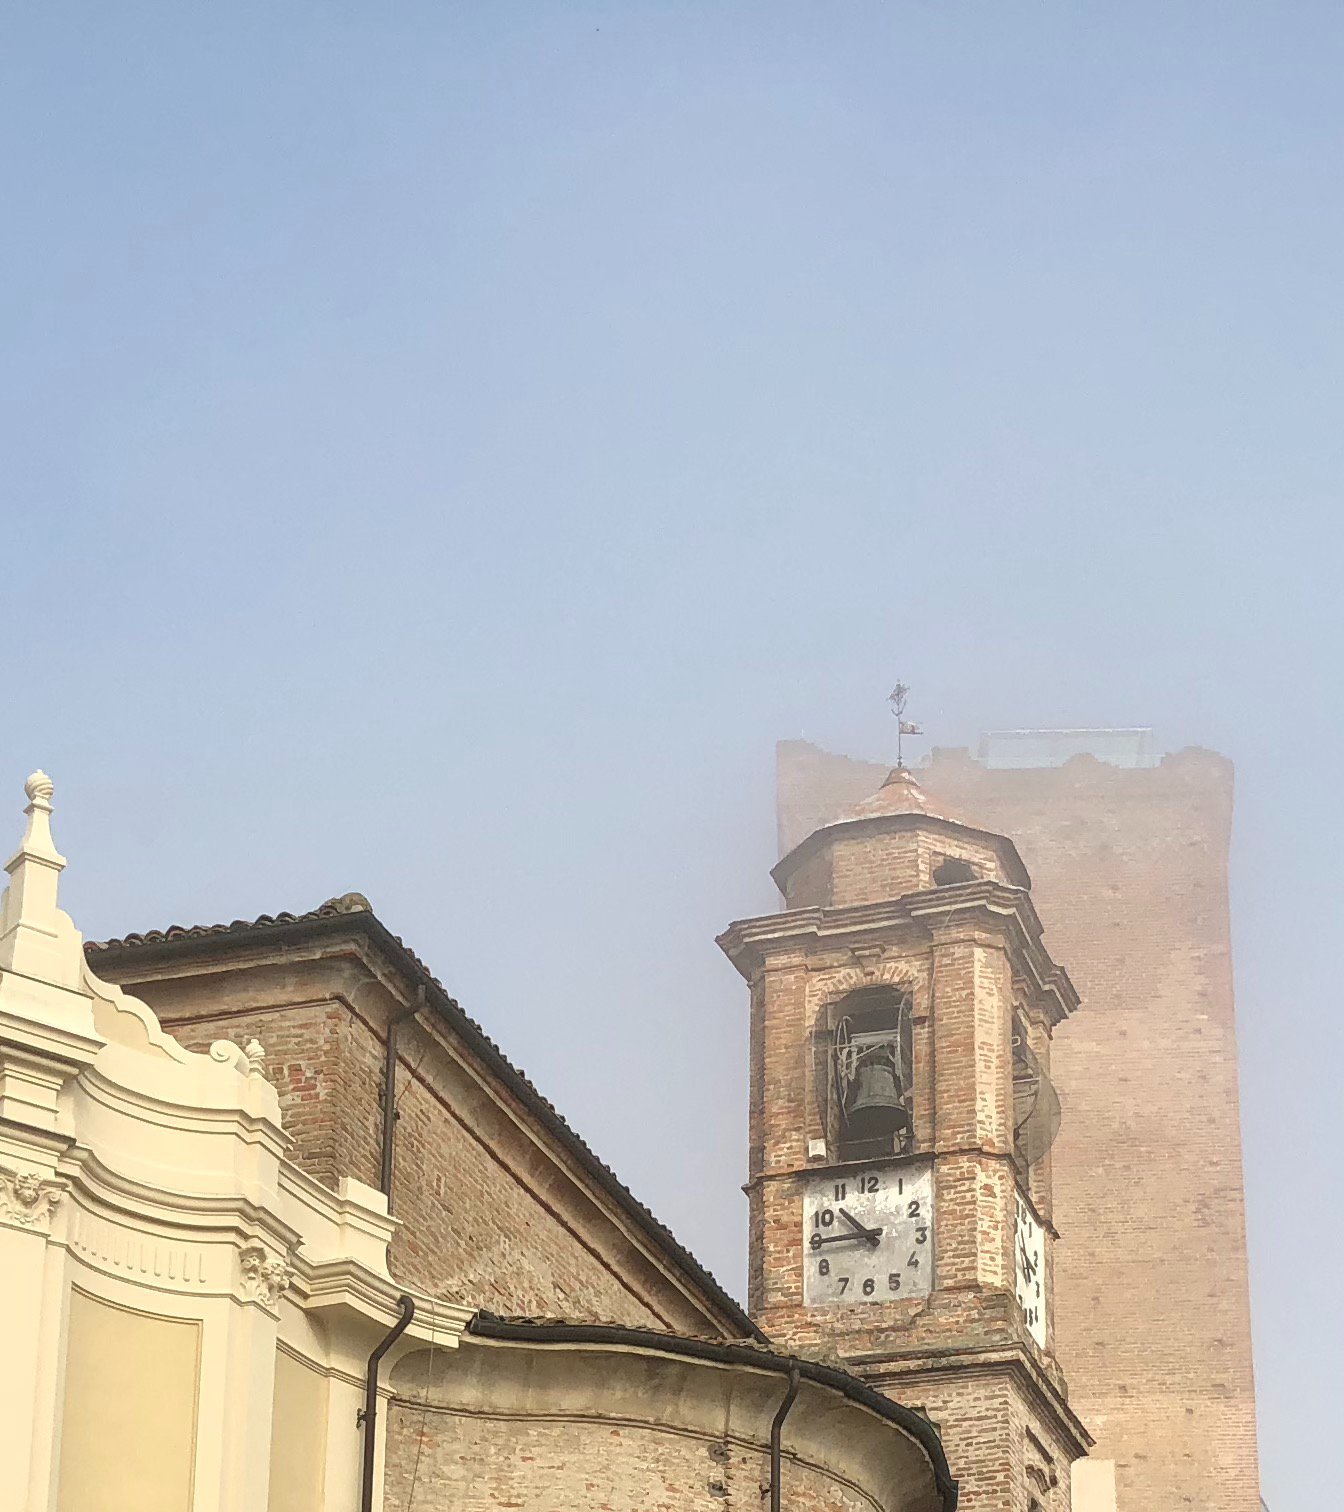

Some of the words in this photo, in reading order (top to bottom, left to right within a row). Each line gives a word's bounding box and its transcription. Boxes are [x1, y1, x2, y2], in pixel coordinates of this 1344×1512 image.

[835, 1183, 846, 1201] 11
[860, 1176, 879, 1194] 12
[898, 1178, 903, 1195] 1
[814, 1208, 834, 1228] 10
[907, 1201, 921, 1218] 2
[915, 1226, 928, 1245] 3
[818, 1259, 830, 1276] 8
[906, 1250, 920, 1269] 4
[837, 1277, 850, 1295] 7
[862, 1278, 875, 1296] 6
[888, 1273, 901, 1291] 5
